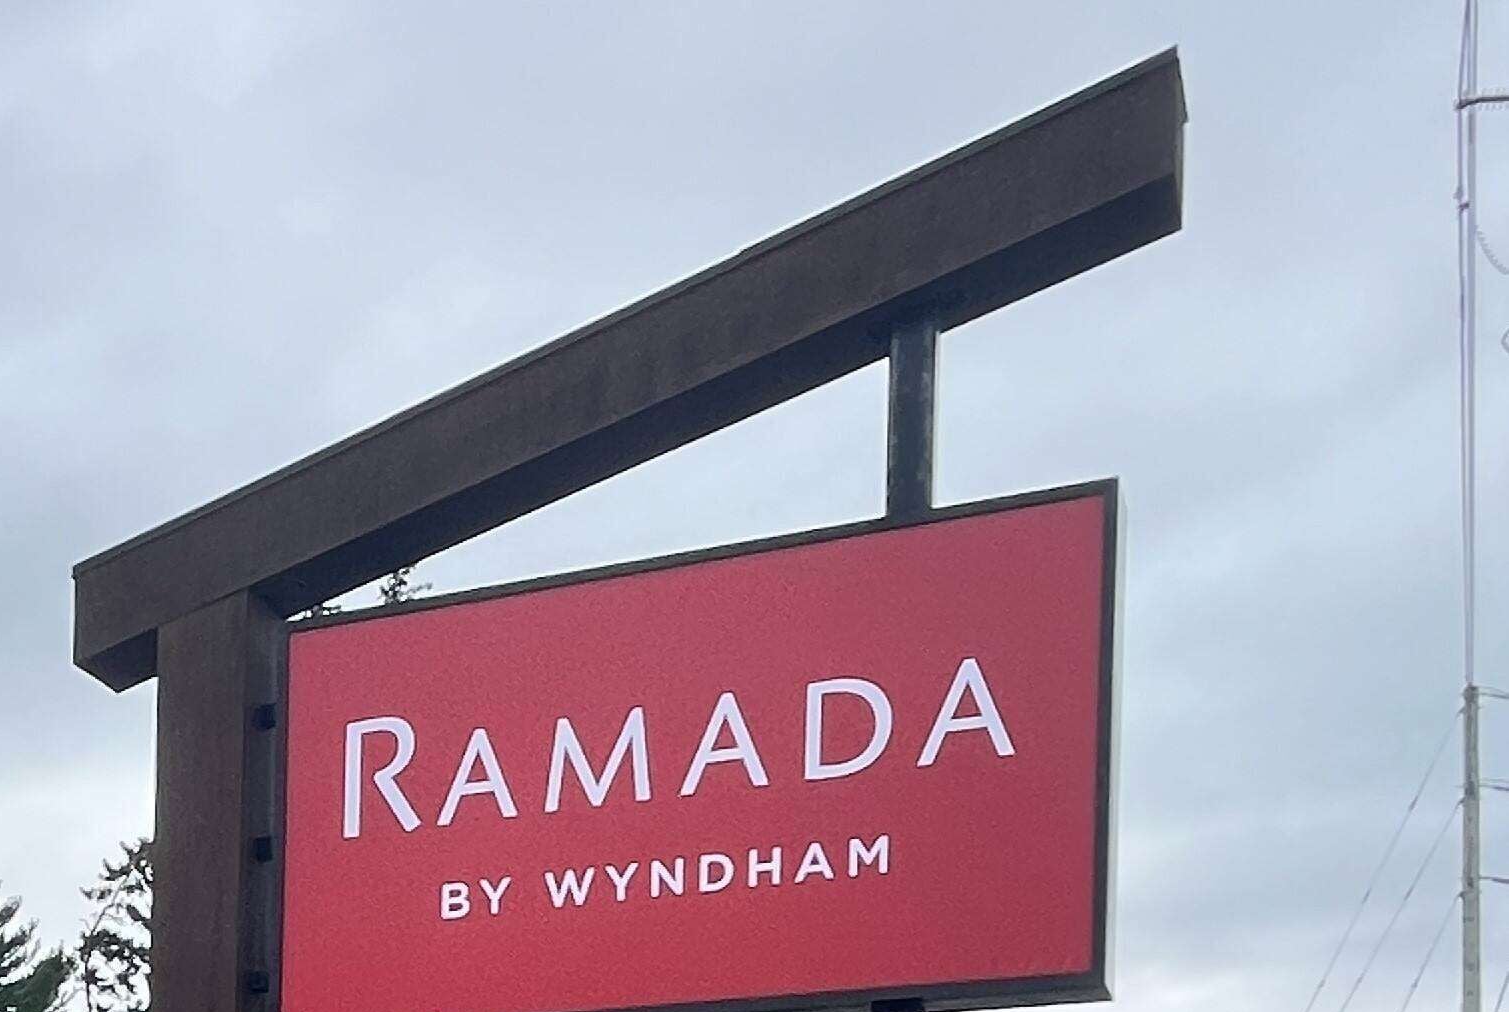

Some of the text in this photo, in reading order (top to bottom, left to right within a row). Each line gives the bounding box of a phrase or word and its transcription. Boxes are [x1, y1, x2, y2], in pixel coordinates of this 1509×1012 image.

[343, 657, 1016, 839] RAMADA
[440, 835, 890, 920] BY WYNDHAM
